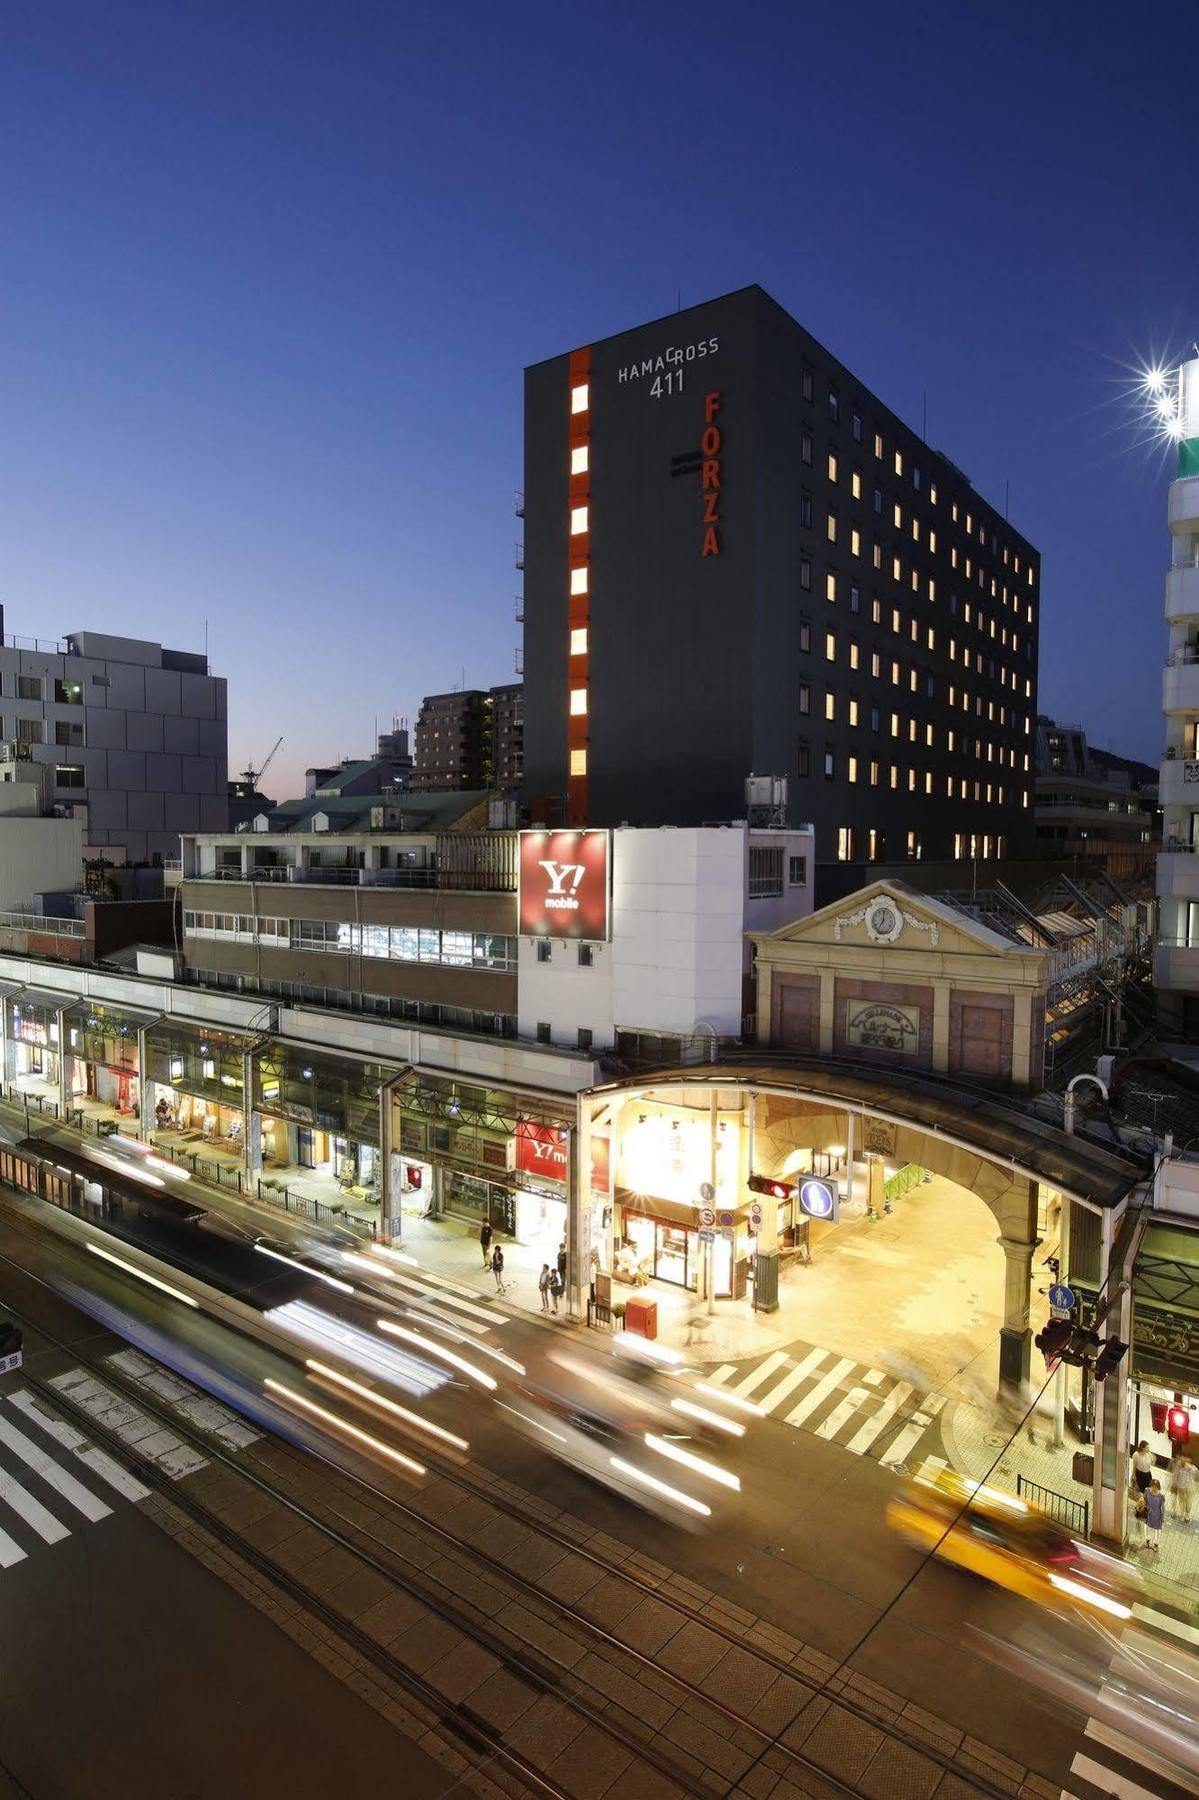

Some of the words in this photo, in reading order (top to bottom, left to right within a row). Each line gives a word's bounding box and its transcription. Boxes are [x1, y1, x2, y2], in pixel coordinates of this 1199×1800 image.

[618, 337, 720, 384] HAMACROSS
[650, 369, 684, 399] 411
[702, 391, 720, 557] FORZA
[538, 860, 586, 896] Y!
[544, 897, 580, 910] mobile
